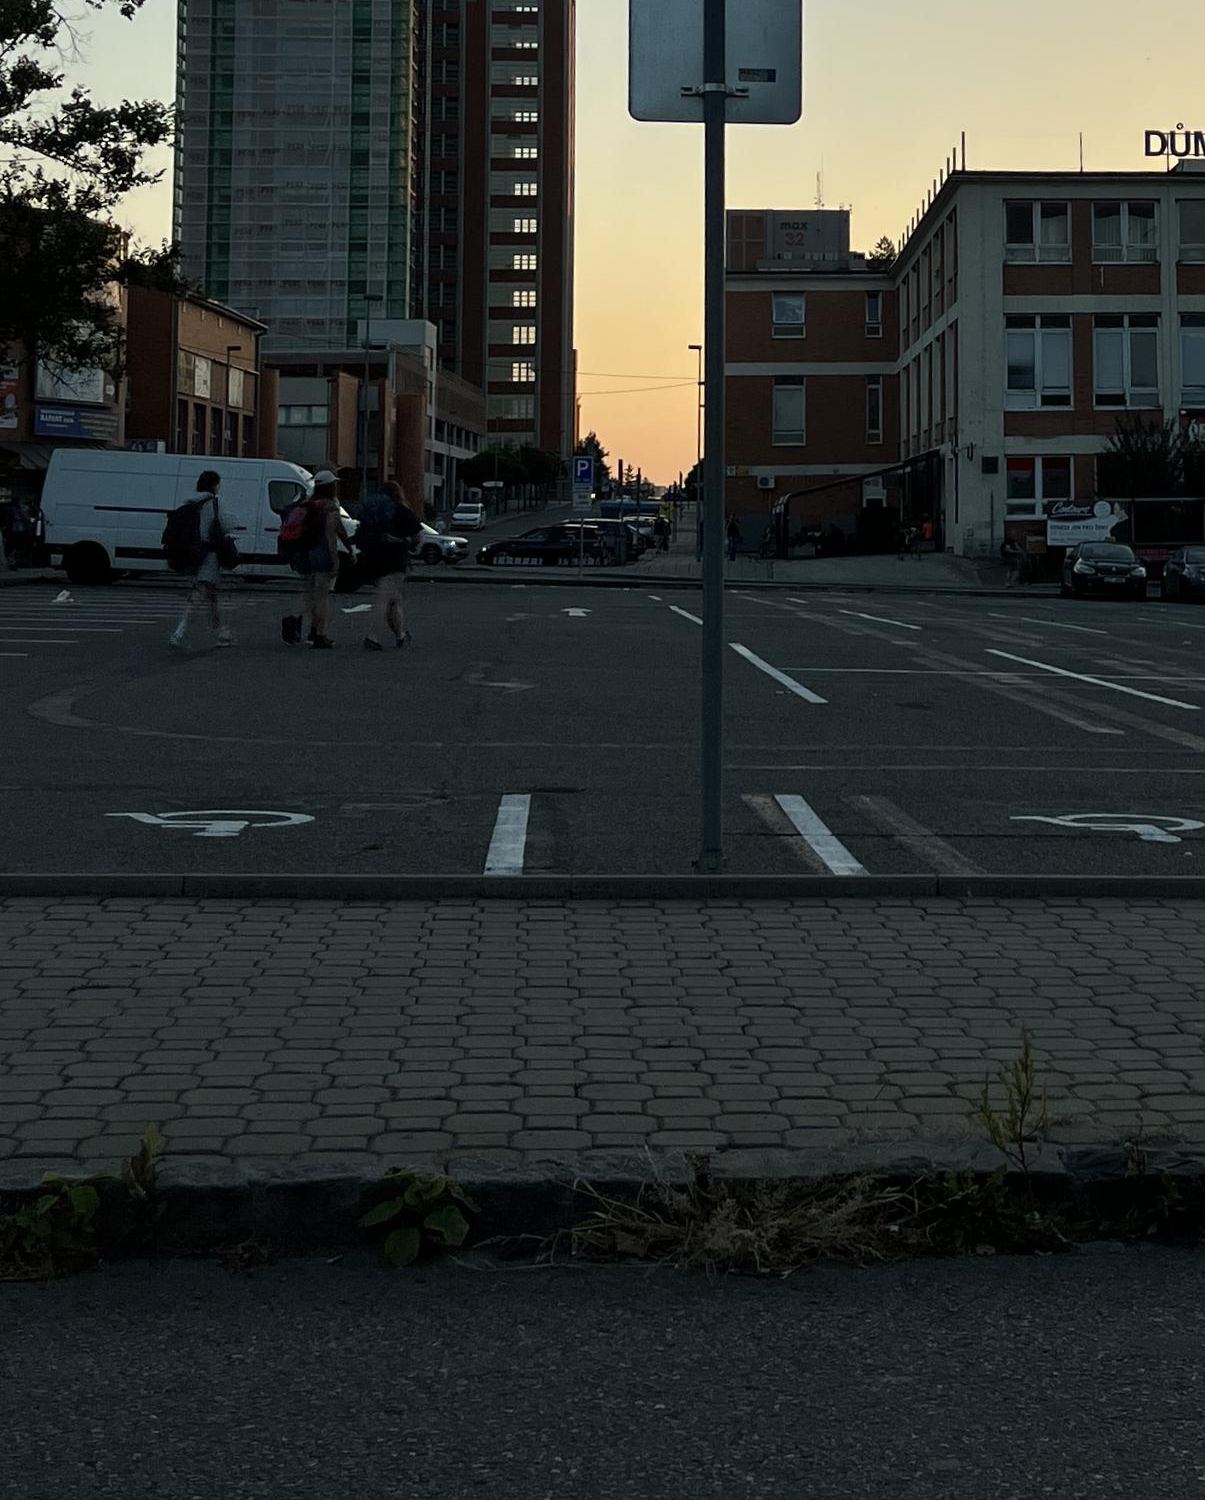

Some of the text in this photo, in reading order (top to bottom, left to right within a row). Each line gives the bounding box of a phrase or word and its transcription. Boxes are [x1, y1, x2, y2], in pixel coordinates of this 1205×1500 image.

[780, 220, 808, 231] max
[785, 232, 805, 246] 32
[577, 459, 590, 477] P
